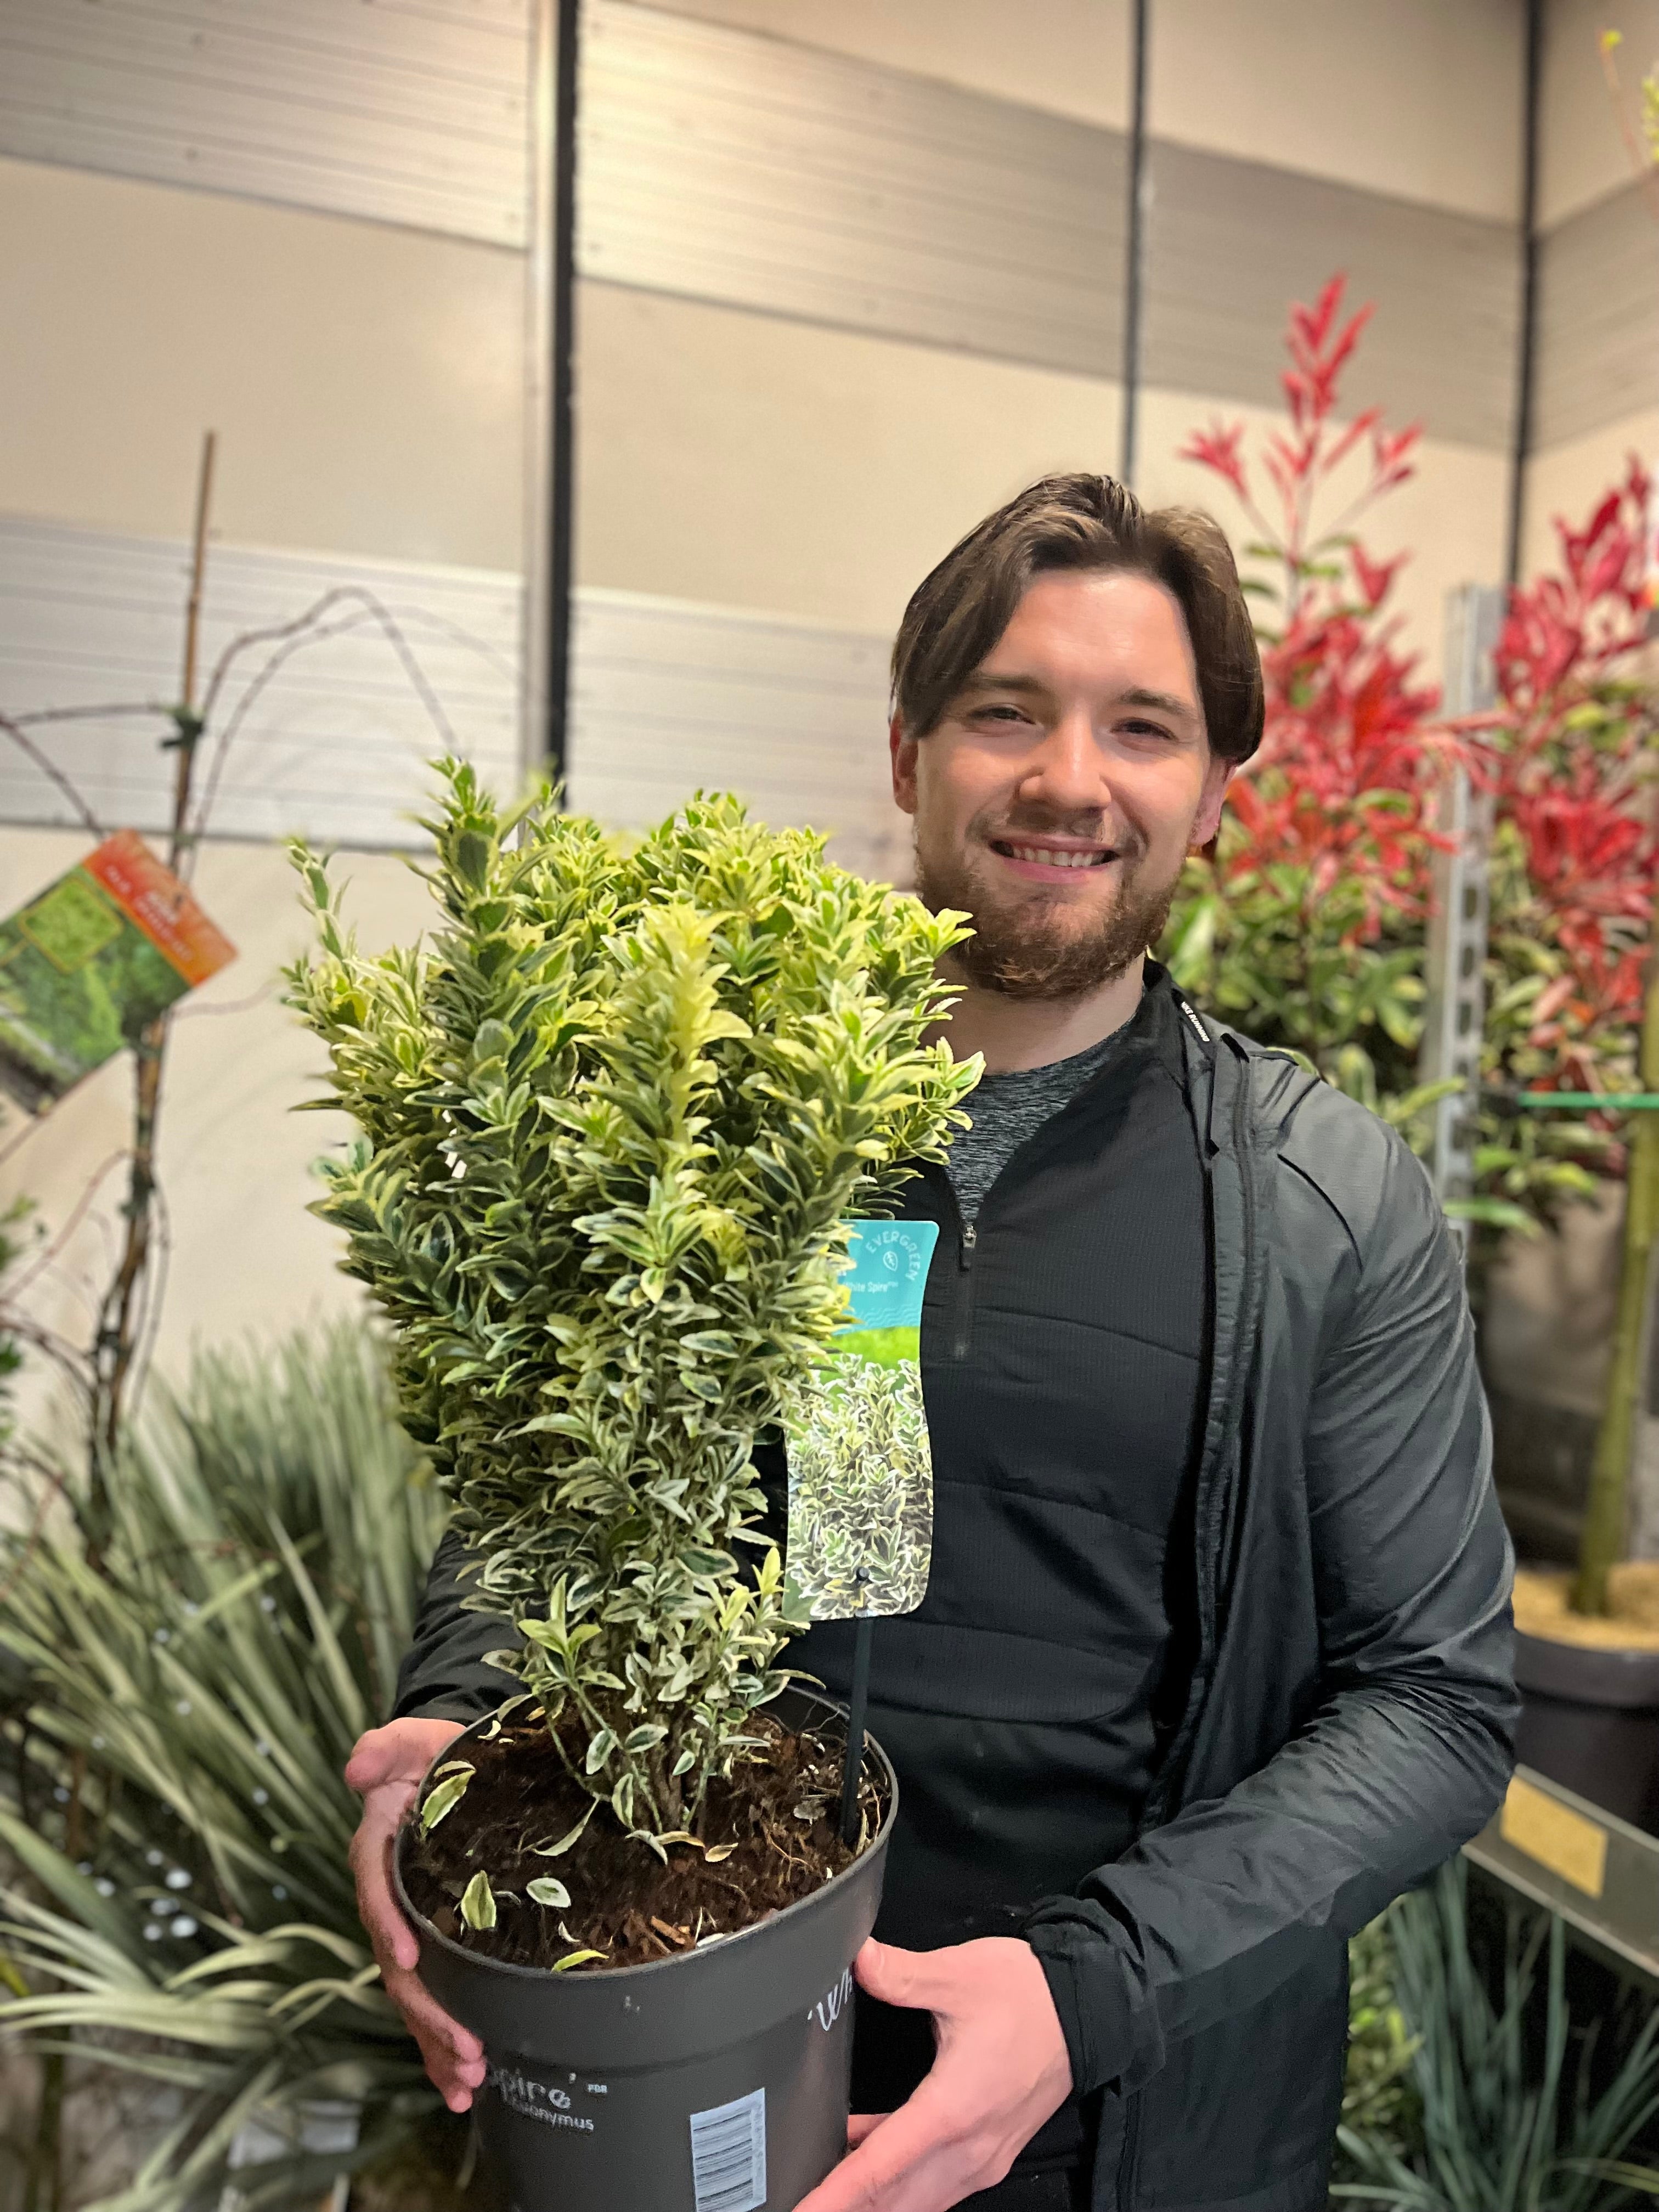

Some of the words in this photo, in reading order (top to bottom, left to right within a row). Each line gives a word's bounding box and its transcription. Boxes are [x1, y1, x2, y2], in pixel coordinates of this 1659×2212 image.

[1181, 1001, 1194, 1015] NIKE
[1188, 1014, 1210, 1042] RUNNING
[865, 1230, 922, 1282] EVERGREEN
[867, 1281, 888, 1294] Spire
